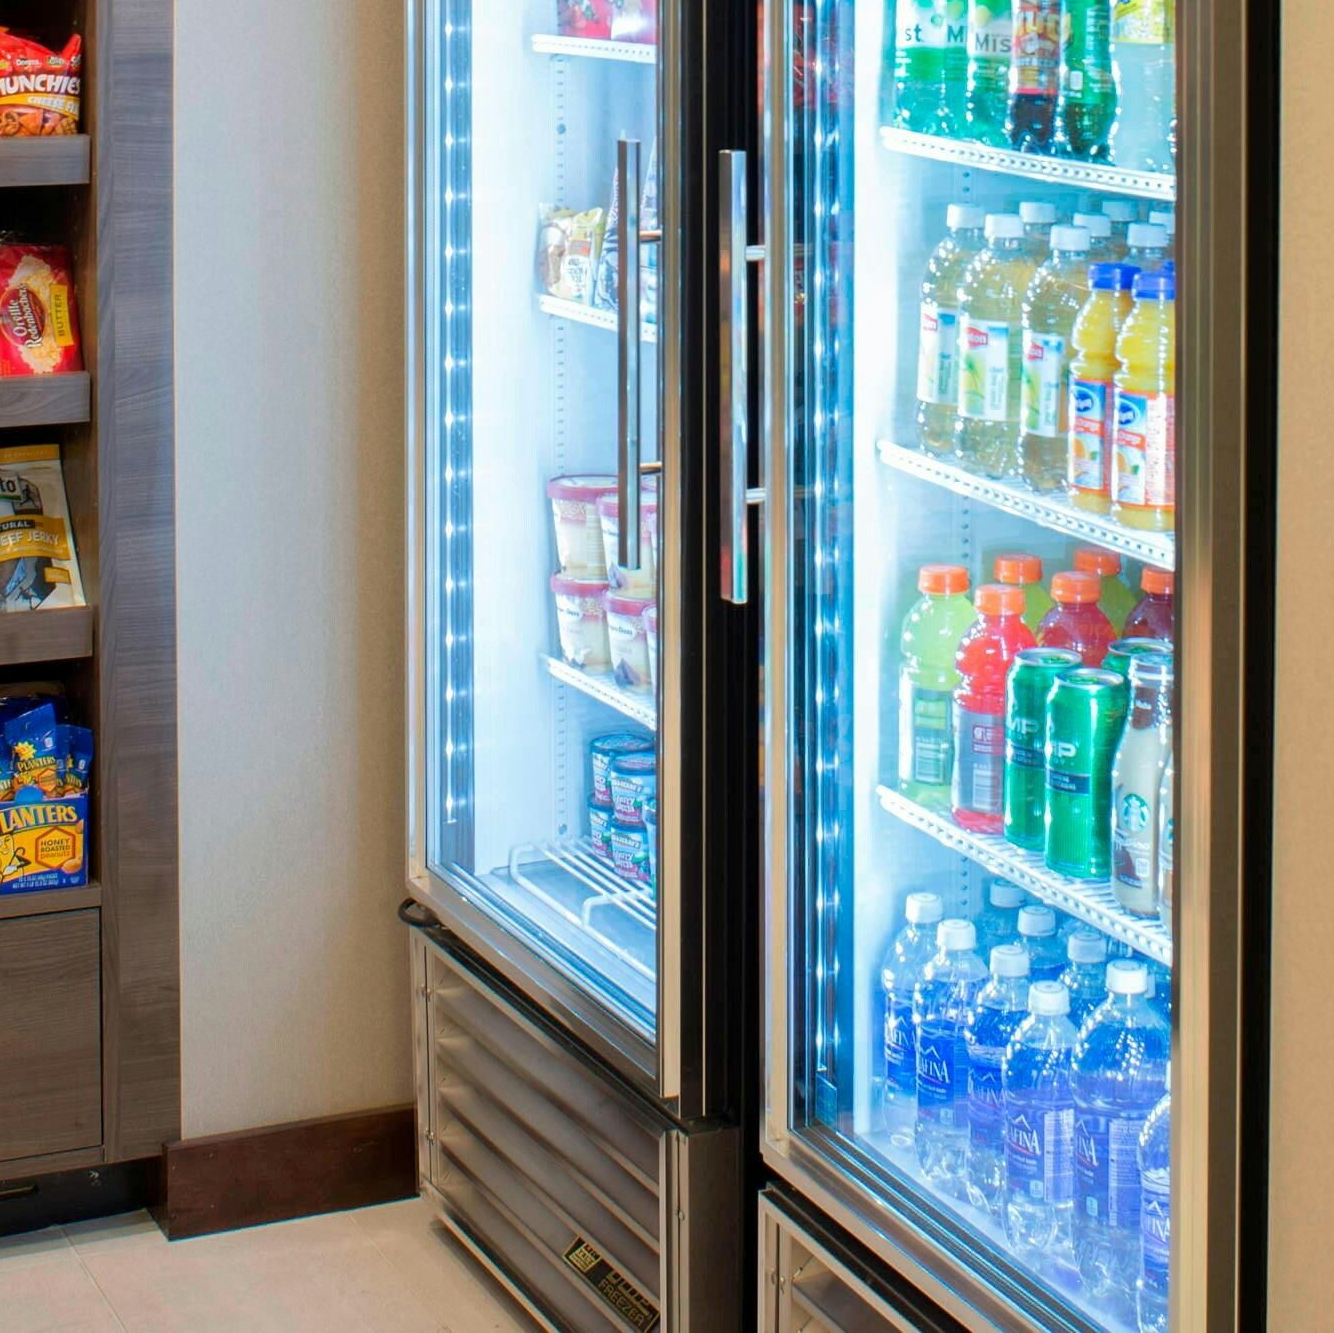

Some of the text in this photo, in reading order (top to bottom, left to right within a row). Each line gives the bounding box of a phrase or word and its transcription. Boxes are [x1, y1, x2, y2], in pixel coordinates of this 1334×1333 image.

[8, 299, 28, 337] Orville
[54, 293, 66, 337] BUTTER
[27, 530, 60, 546] JERKY
[16, 756, 56, 772] PLANTERS
[40, 837, 70, 847] HONEY
[40, 845, 71, 853] ROASTED
